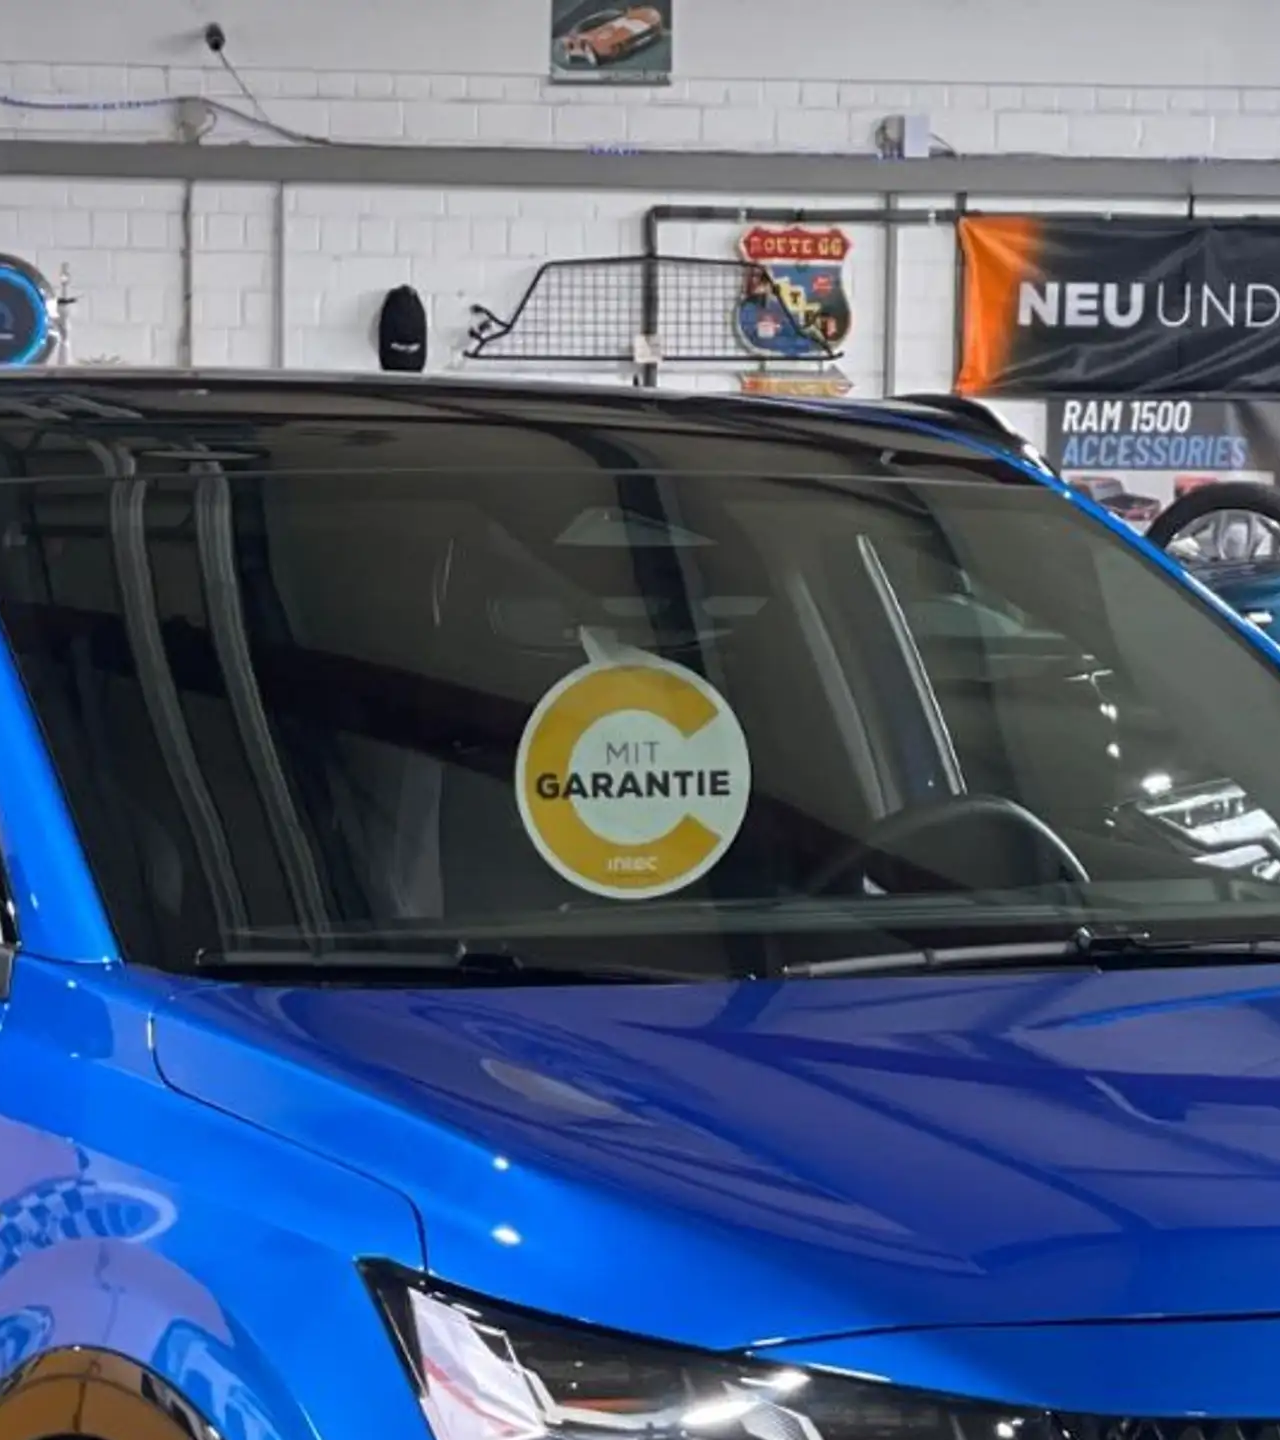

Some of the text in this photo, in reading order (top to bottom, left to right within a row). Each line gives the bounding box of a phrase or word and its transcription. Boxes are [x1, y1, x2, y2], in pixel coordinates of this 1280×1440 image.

[750, 237, 842, 256] ROUTE 66
[1017, 282, 1145, 327] NEU
[1062, 401, 1193, 434] RAM 1500
[1062, 435, 1248, 468] ACCESSORIES
[606, 741, 660, 766] MIT
[536, 769, 730, 800] GARANTIE
